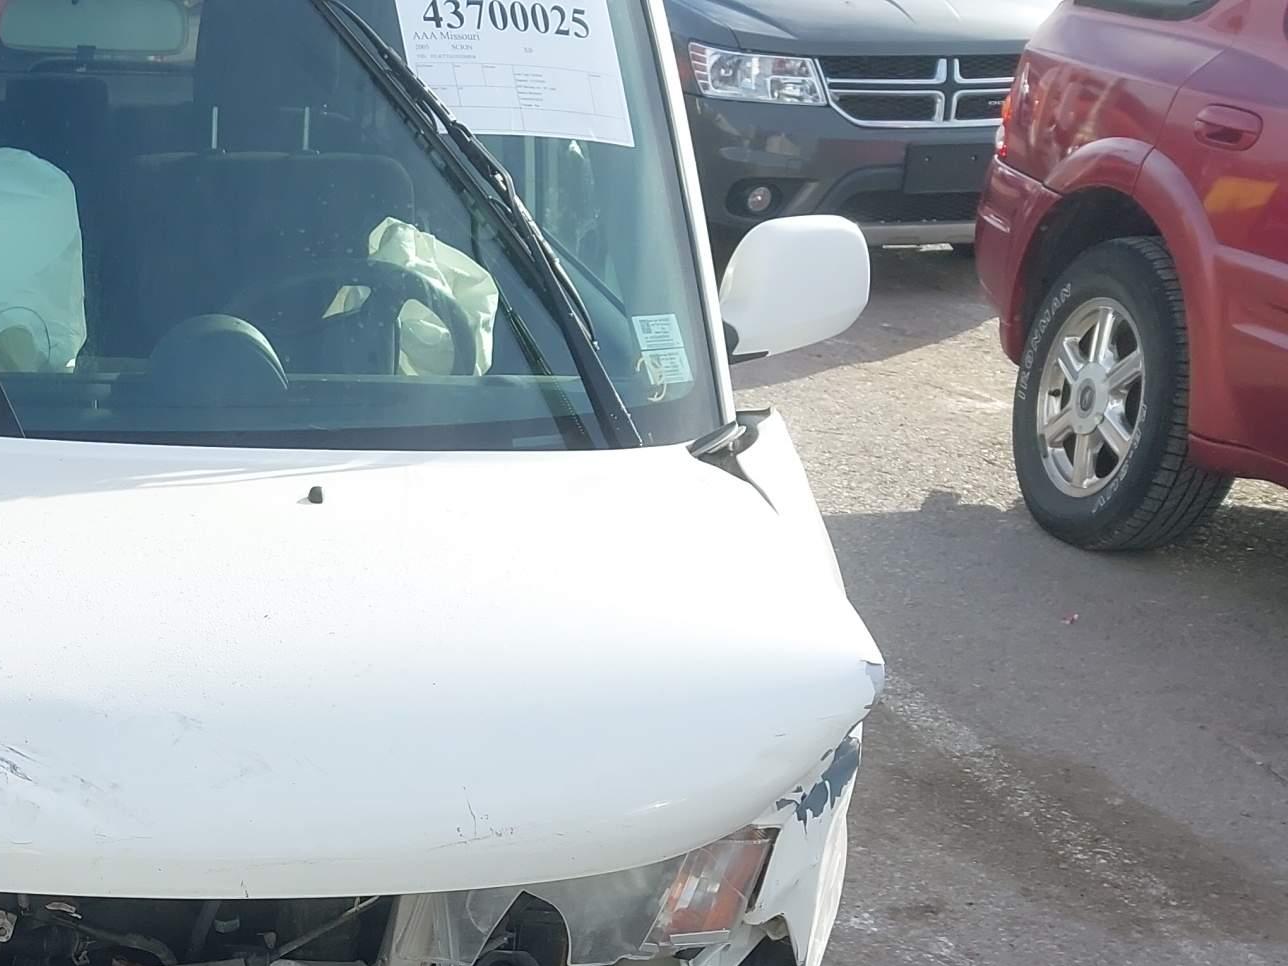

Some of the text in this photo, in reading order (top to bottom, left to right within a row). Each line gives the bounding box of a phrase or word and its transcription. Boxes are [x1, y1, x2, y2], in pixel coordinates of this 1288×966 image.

[423, 0, 590, 38] 43700025
[413, 31, 480, 41] AAA Missouri
